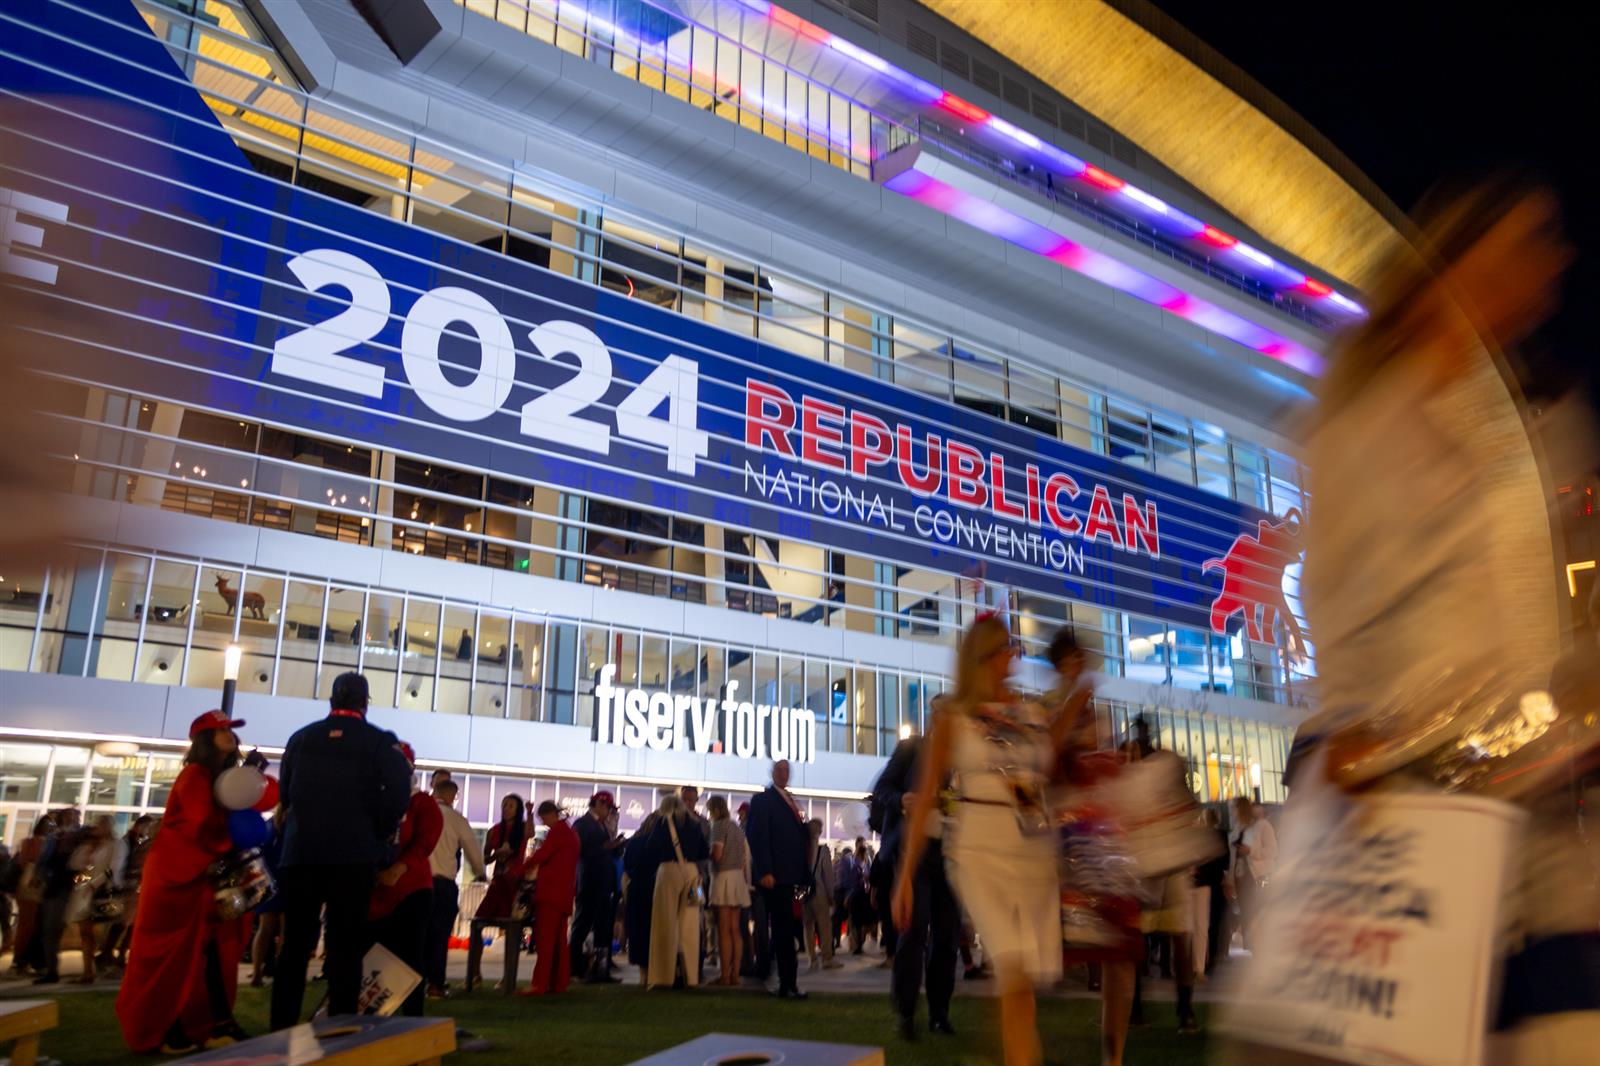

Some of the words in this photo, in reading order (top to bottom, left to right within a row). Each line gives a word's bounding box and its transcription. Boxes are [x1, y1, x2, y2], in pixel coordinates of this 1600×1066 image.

[271, 248, 709, 477] 2024
[744, 377, 1160, 560] REPUBLICAN
[744, 460, 906, 532] NATIONAL
[914, 504, 1084, 575] CONVENTION
